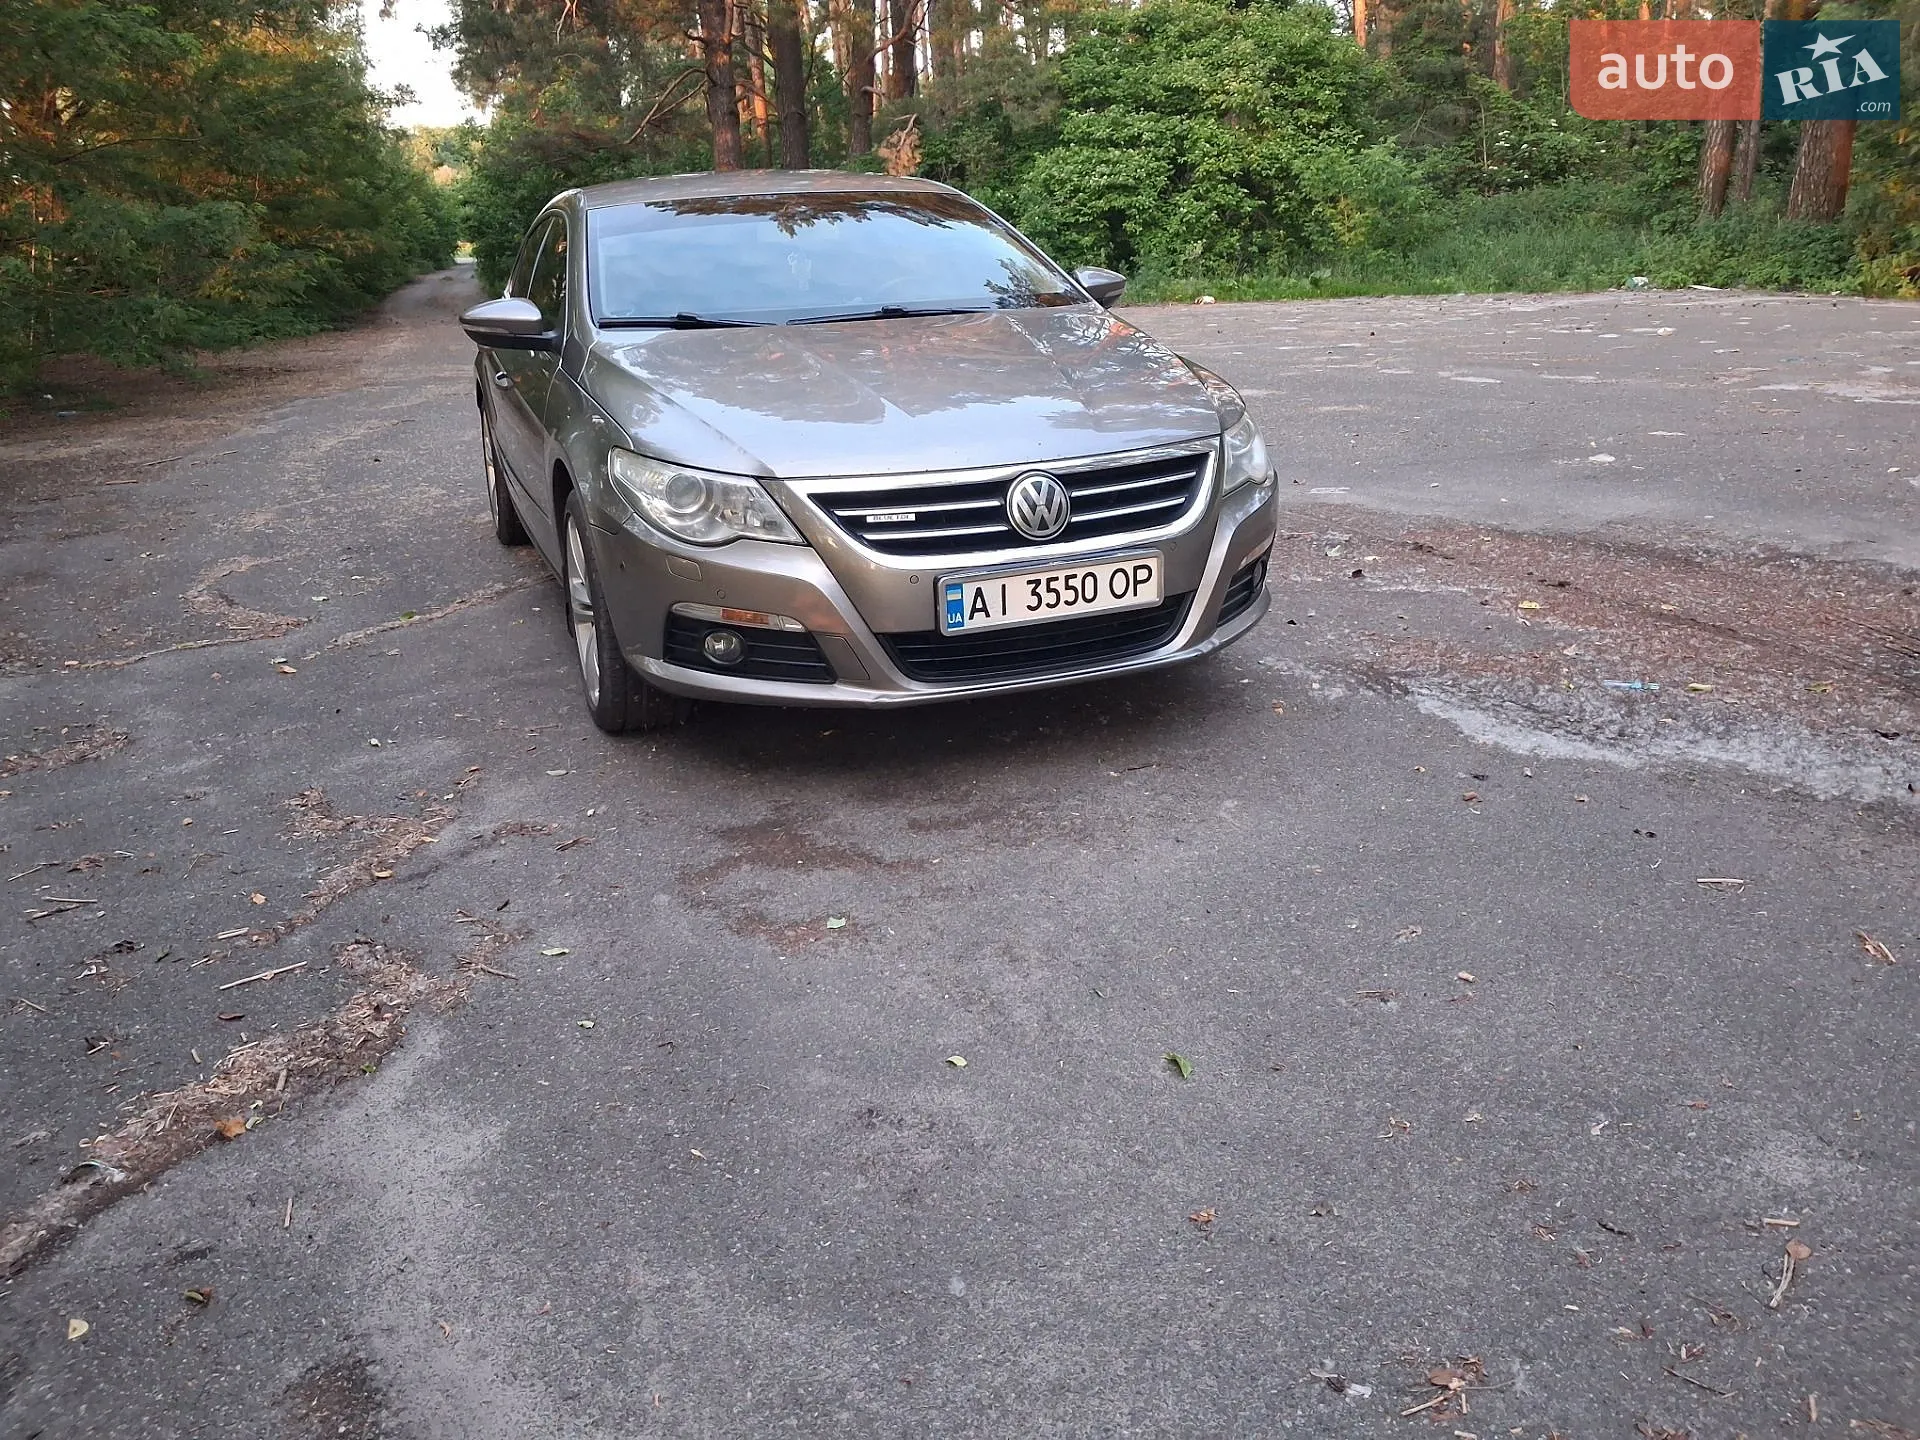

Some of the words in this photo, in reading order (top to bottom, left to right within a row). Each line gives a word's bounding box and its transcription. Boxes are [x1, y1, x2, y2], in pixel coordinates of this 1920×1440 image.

[968, 583, 1007, 620] AI
[1026, 571, 1098, 611] 3550
[1109, 564, 1153, 599] OP
[947, 612, 963, 624] UA
